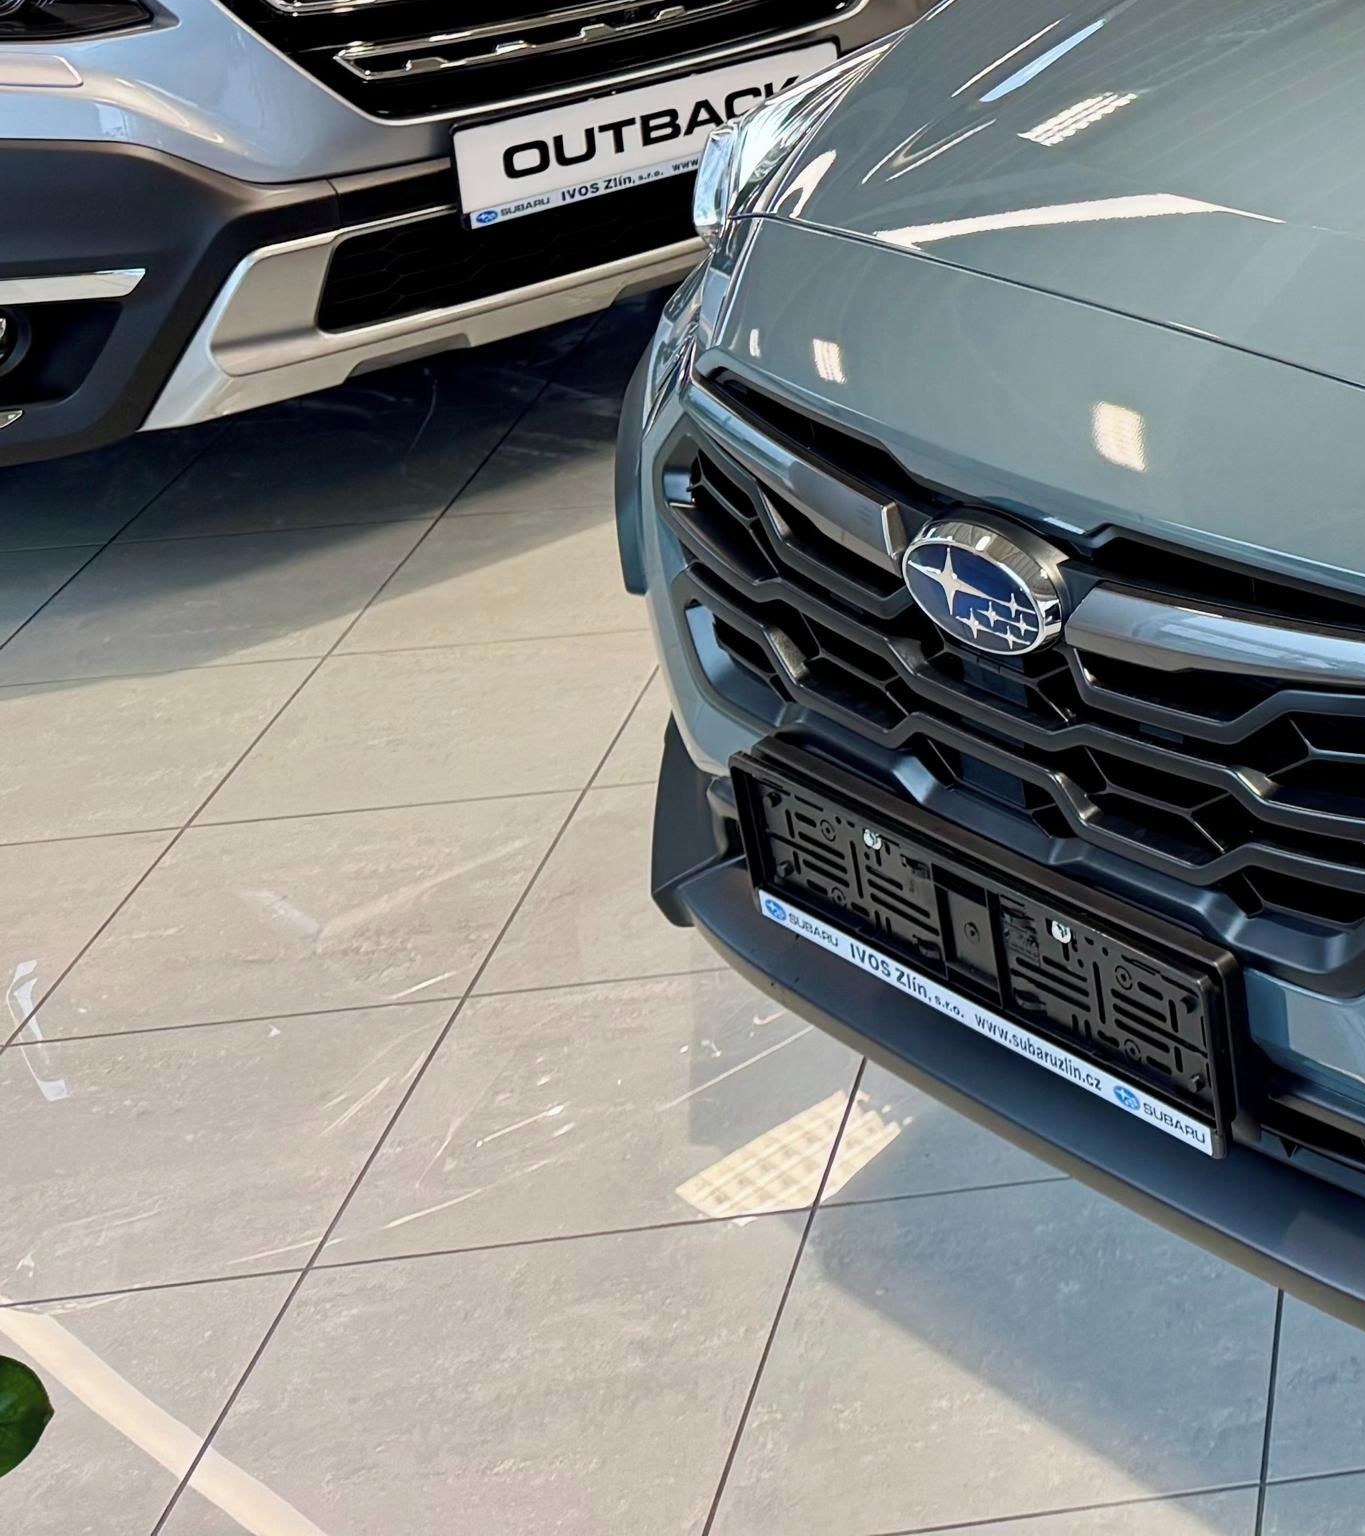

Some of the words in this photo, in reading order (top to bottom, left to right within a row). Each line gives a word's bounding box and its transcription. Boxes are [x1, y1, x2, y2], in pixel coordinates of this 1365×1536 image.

[500, 195, 551, 217] SUBARU
[561, 181, 600, 202] IVOS
[788, 912, 839, 948] SUBARU
[849, 942, 892, 978] IVOS
[974, 1013, 1102, 1092] www.subaruzlin.cz
[1142, 1102, 1206, 1145] SUBARU
